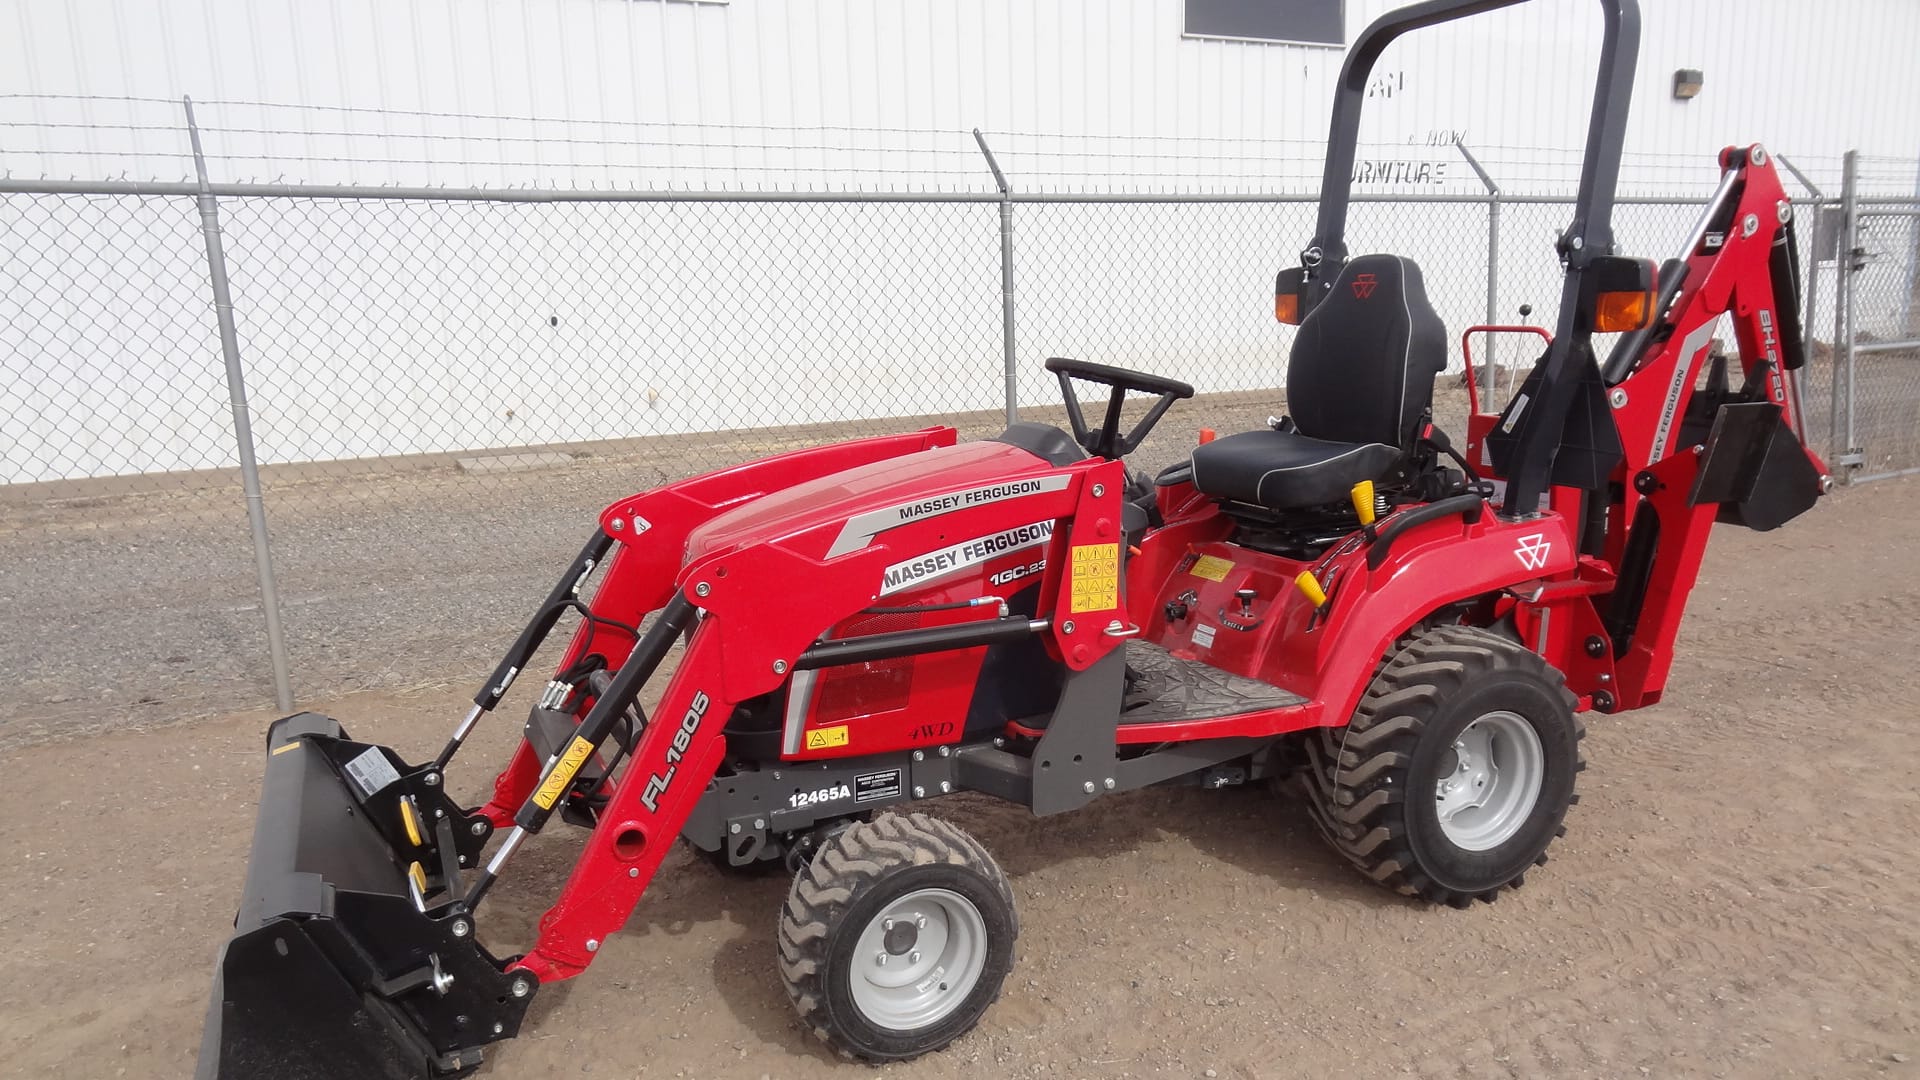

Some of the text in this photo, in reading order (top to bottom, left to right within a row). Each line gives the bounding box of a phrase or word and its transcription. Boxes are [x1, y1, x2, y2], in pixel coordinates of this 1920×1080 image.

[1424, 129, 1467, 147] NOW
[1350, 161, 1447, 184] URNITURE
[1660, 369, 1684, 432] FERGUSON
[899, 480, 1041, 519] MASSEY FERGUSON
[884, 521, 1053, 588] MASSEY FERGUSON
[908, 721, 954, 740] 4WD
[641, 690, 710, 813] FL.1805
[788, 784, 851, 808] 12465A
